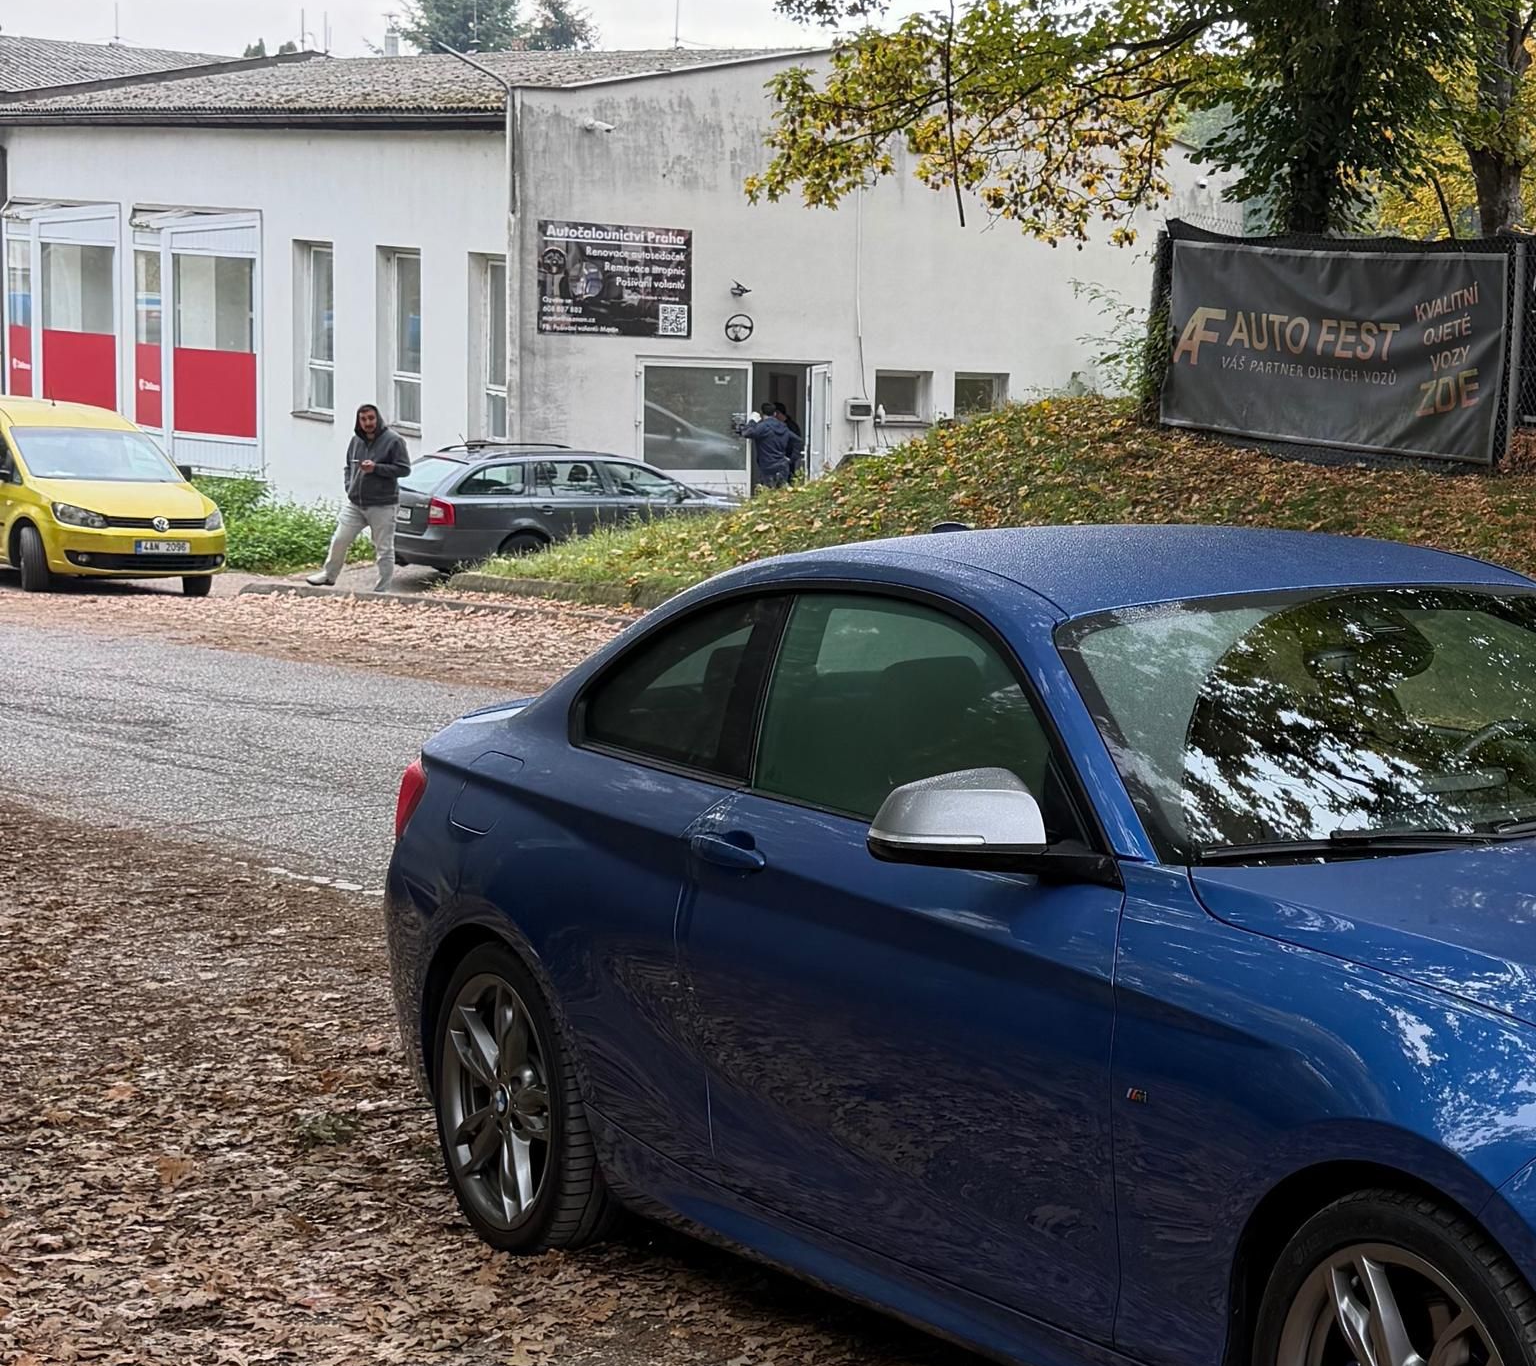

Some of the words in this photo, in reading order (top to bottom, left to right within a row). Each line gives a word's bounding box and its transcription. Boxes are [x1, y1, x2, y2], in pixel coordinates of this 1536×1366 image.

[546, 225, 645, 243] Autočalounictví
[647, 230, 685, 245] Praha
[1414, 281, 1479, 323] KVALITNÍ
[1226, 311, 1310, 354] AUTO
[1315, 319, 1401, 361] FEST
[1423, 313, 1472, 347] OJETÉ
[1221, 354, 1245, 371] VÁŠ
[1250, 360, 1304, 378] PARTNER
[1308, 362, 1359, 383] OJETÝCH
[1363, 368, 1398, 386] VOZŮ
[1430, 345, 1471, 372] VOZY
[1415, 368, 1480, 418] ZDE
